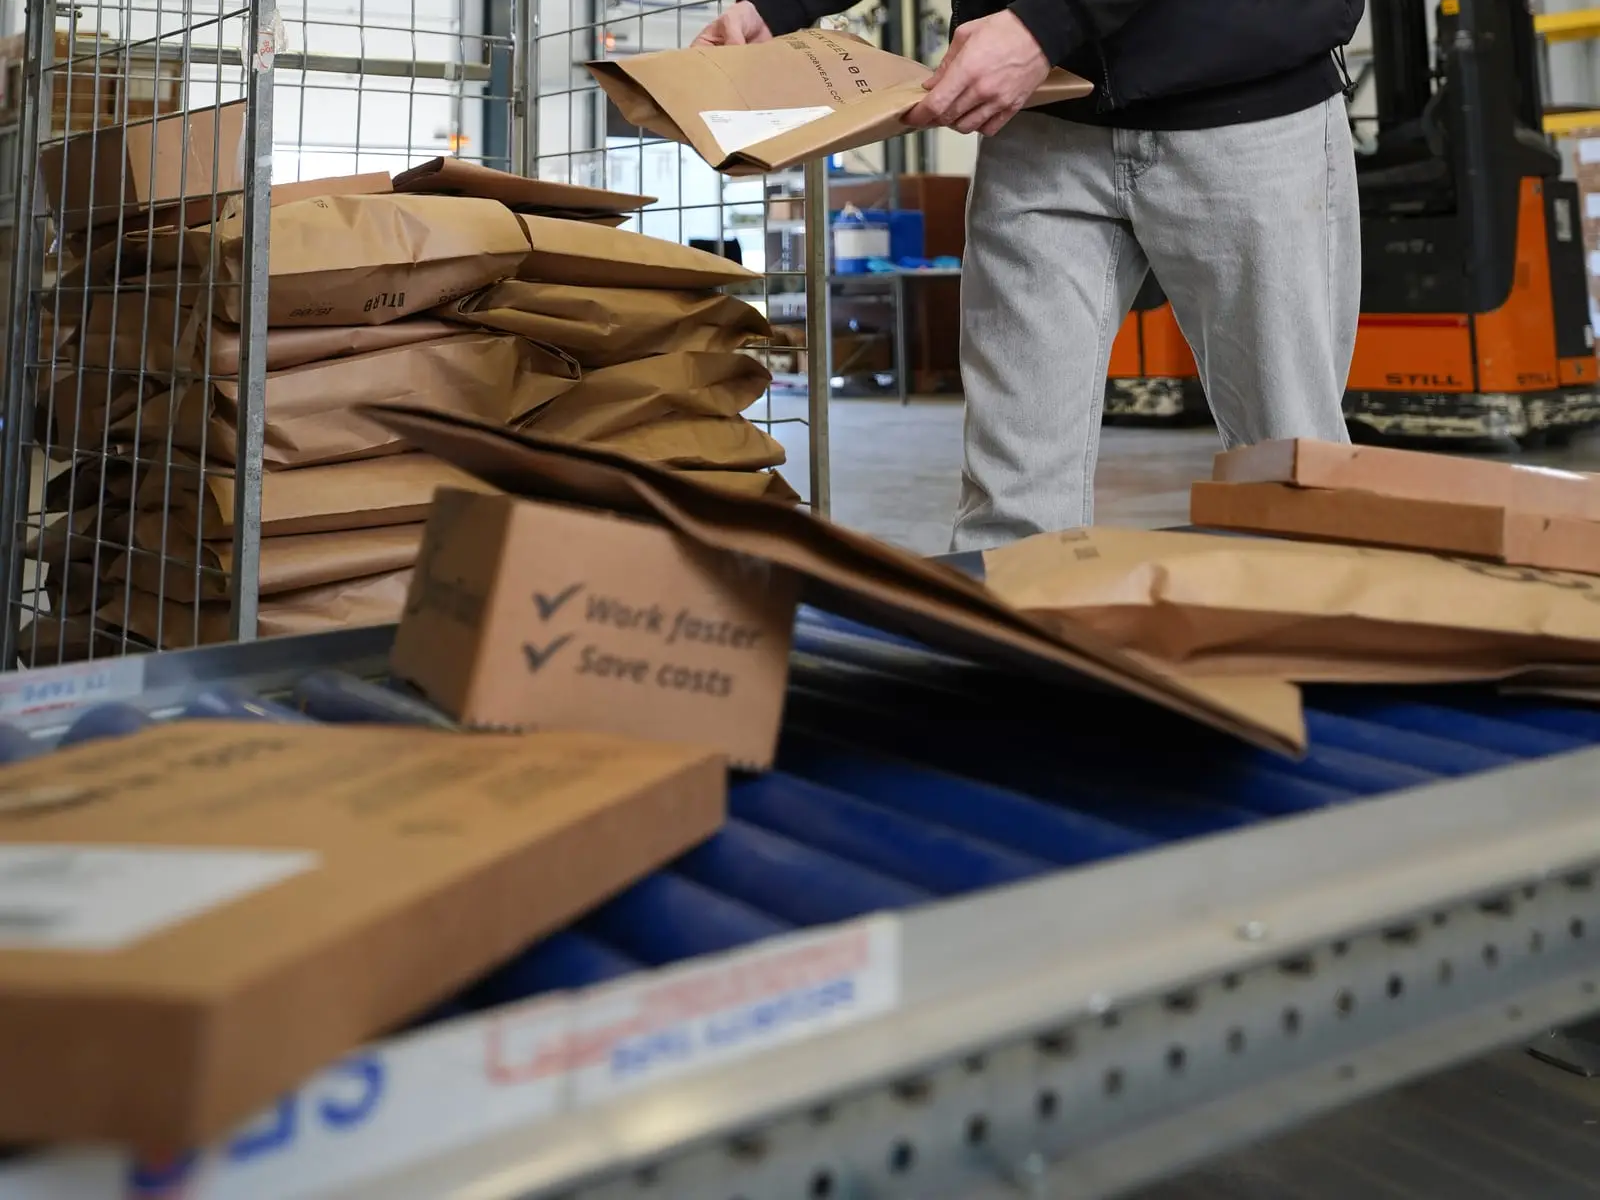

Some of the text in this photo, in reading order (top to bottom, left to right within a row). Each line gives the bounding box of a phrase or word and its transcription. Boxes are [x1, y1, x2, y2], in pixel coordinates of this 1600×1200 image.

[1385, 373, 1463, 386] STILL
[585, 594, 765, 650] Work faster
[573, 644, 735, 698] Save costs
